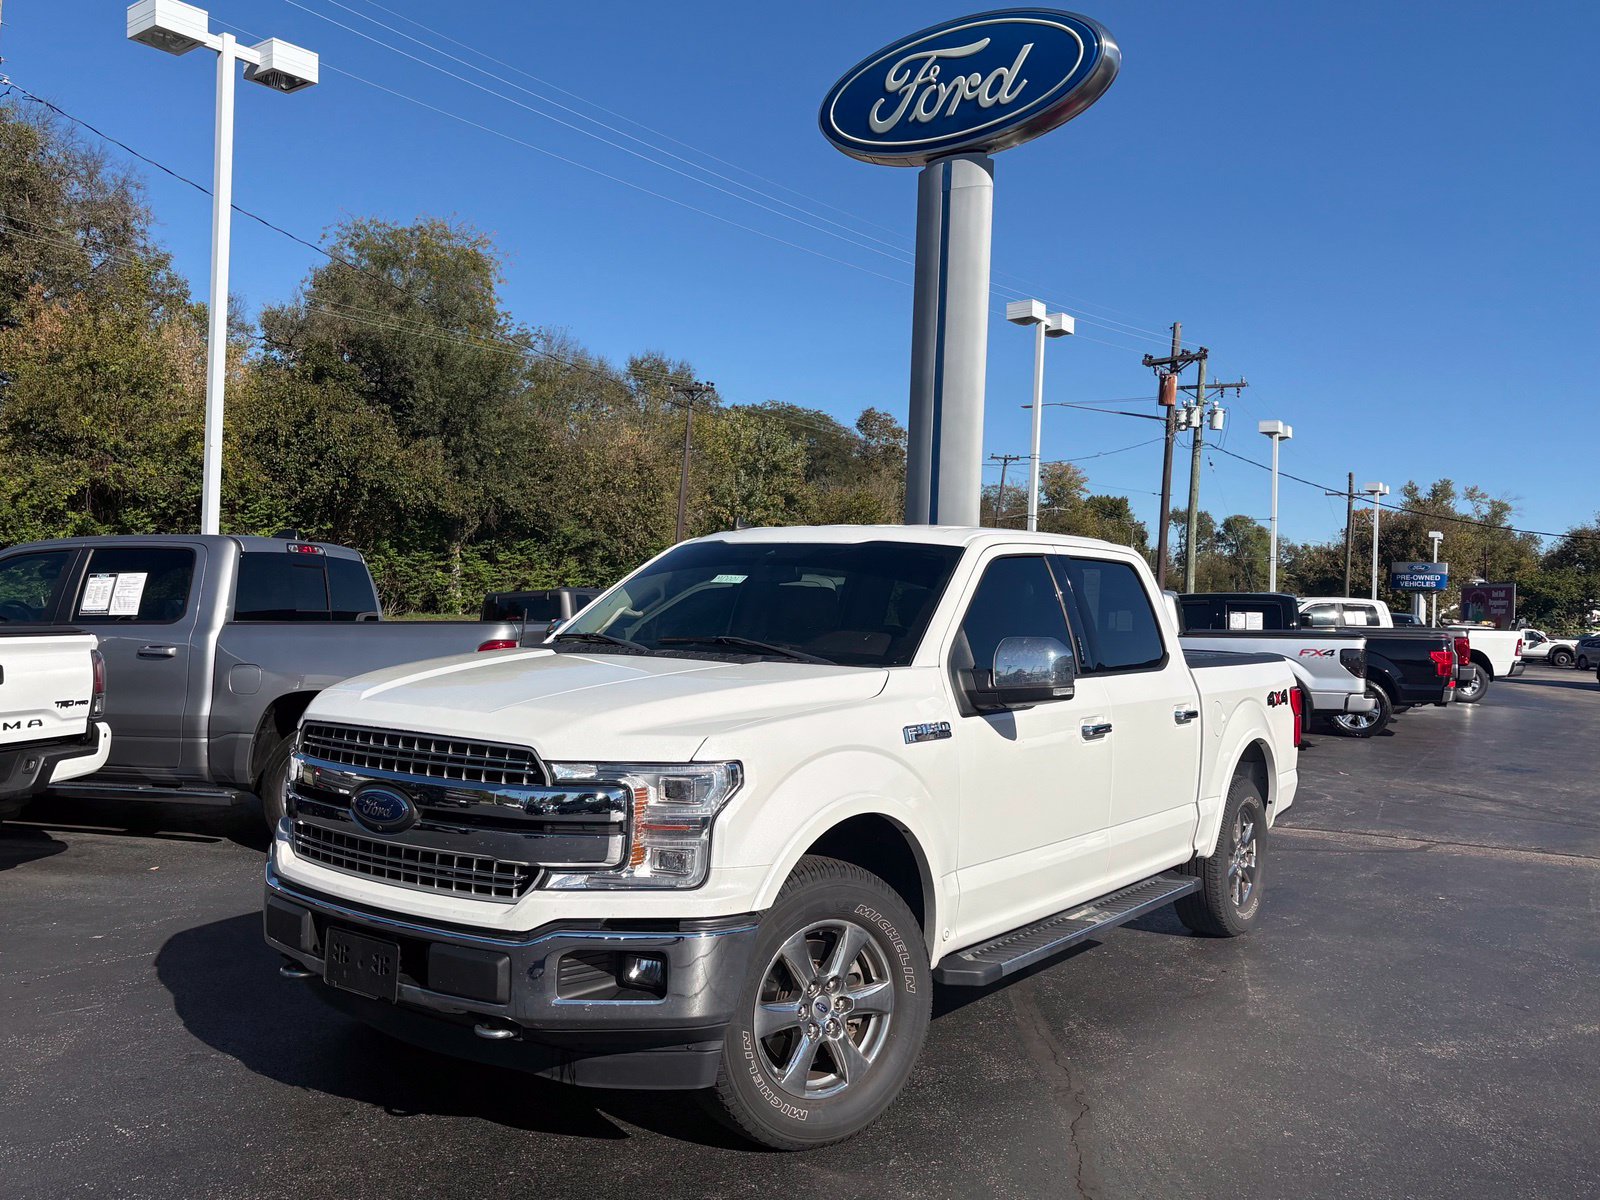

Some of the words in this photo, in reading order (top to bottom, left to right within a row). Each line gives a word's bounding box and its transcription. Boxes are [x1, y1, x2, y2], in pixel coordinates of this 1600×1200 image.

[869, 37, 1035, 134] Ford
[1298, 649, 1336, 657] FX4
[54, 699, 75, 709] TRD
[75, 699, 89, 707] PRO
[362, 796, 393, 818] Ford
[854, 904, 916, 994] MICHELIN
[742, 1030, 809, 1121] MICHELIN
